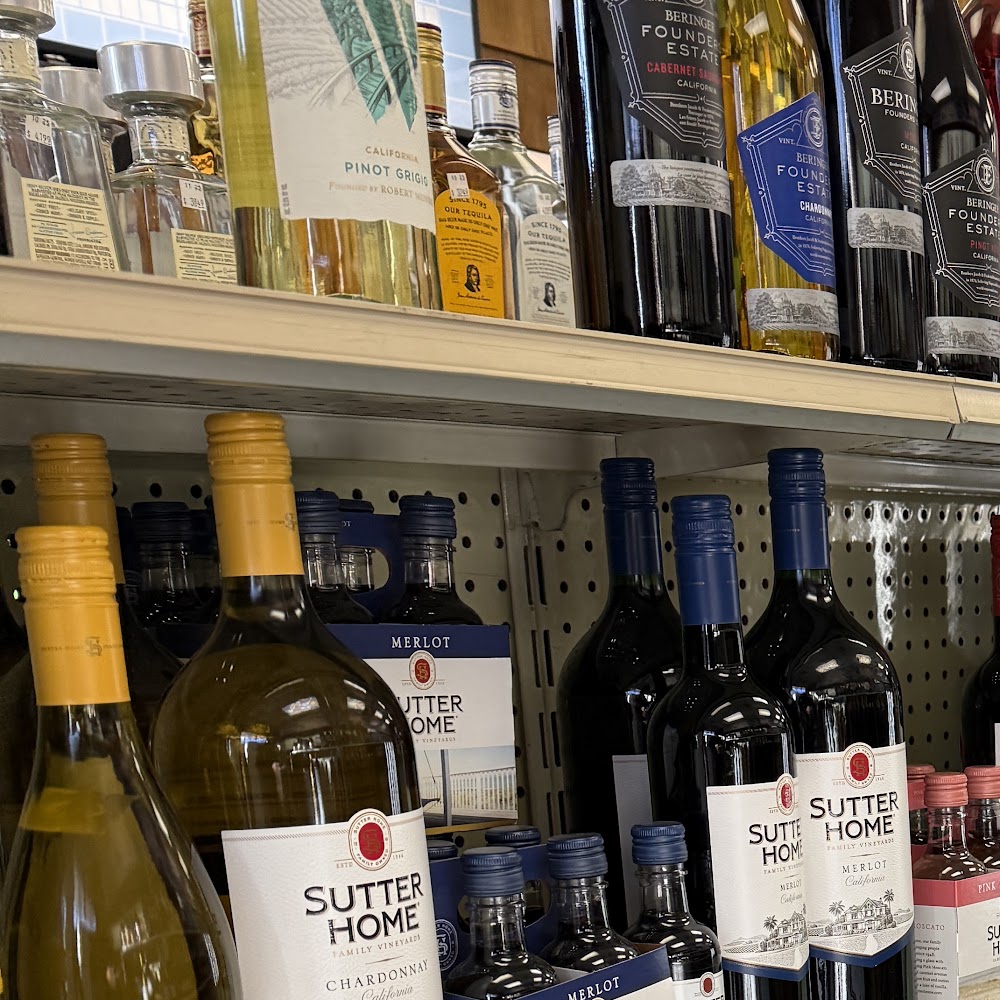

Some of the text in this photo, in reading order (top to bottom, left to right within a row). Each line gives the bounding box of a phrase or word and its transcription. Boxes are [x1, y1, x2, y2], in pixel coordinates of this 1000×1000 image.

[664, 9, 716, 32] BERINGER
[641, 24, 720, 49] FOUNDER
[667, 42, 719, 66] ESTATE
[646, 61, 696, 77] CABERNET
[877, 68, 893, 76] VINT.
[778, 136, 796, 147] VINT.
[365, 146, 419, 163] CALIFORNIA
[344, 161, 429, 187] PINOT GRIGIO
[381, 185, 413, 199] ROBERT
[444, 206, 492, 221] OUR TEQUILA
[391, 636, 450, 649] MERLOT
[810, 790, 899, 820] SUTTER
[749, 817, 801, 845] SUTTE
[825, 813, 897, 842] HOME
[762, 842, 803, 866] HOME
[841, 859, 888, 875] MERLOT
[845, 874, 886, 888] California
[978, 880, 996, 894] PINK
[303, 871, 424, 916] SUTTER
[327, 902, 421, 945] HOME
[326, 959, 429, 992] CHARDONNAY
